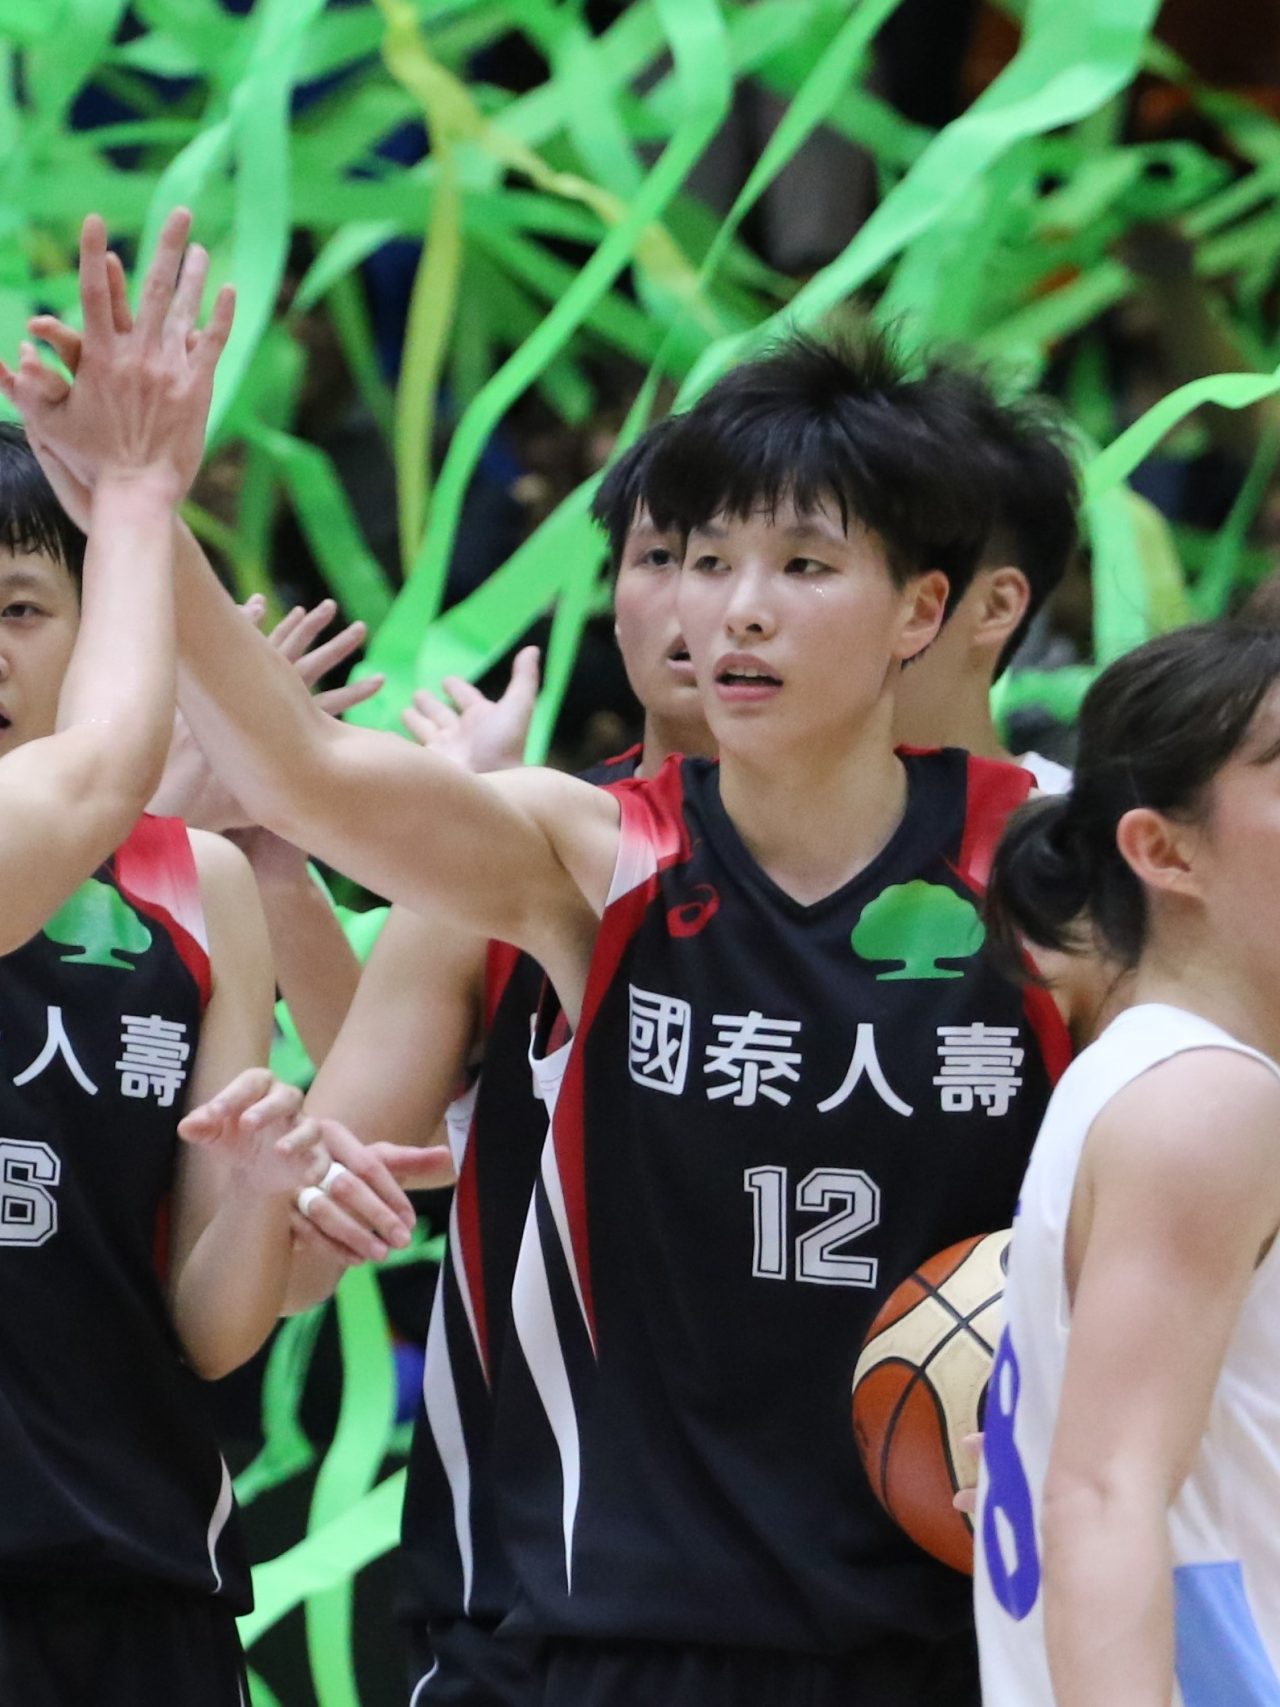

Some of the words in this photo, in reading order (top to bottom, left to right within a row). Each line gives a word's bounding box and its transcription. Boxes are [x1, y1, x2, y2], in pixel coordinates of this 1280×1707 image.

[628, 983, 1024, 1117] 國泰人壽
[743, 1165, 881, 1289] 12
